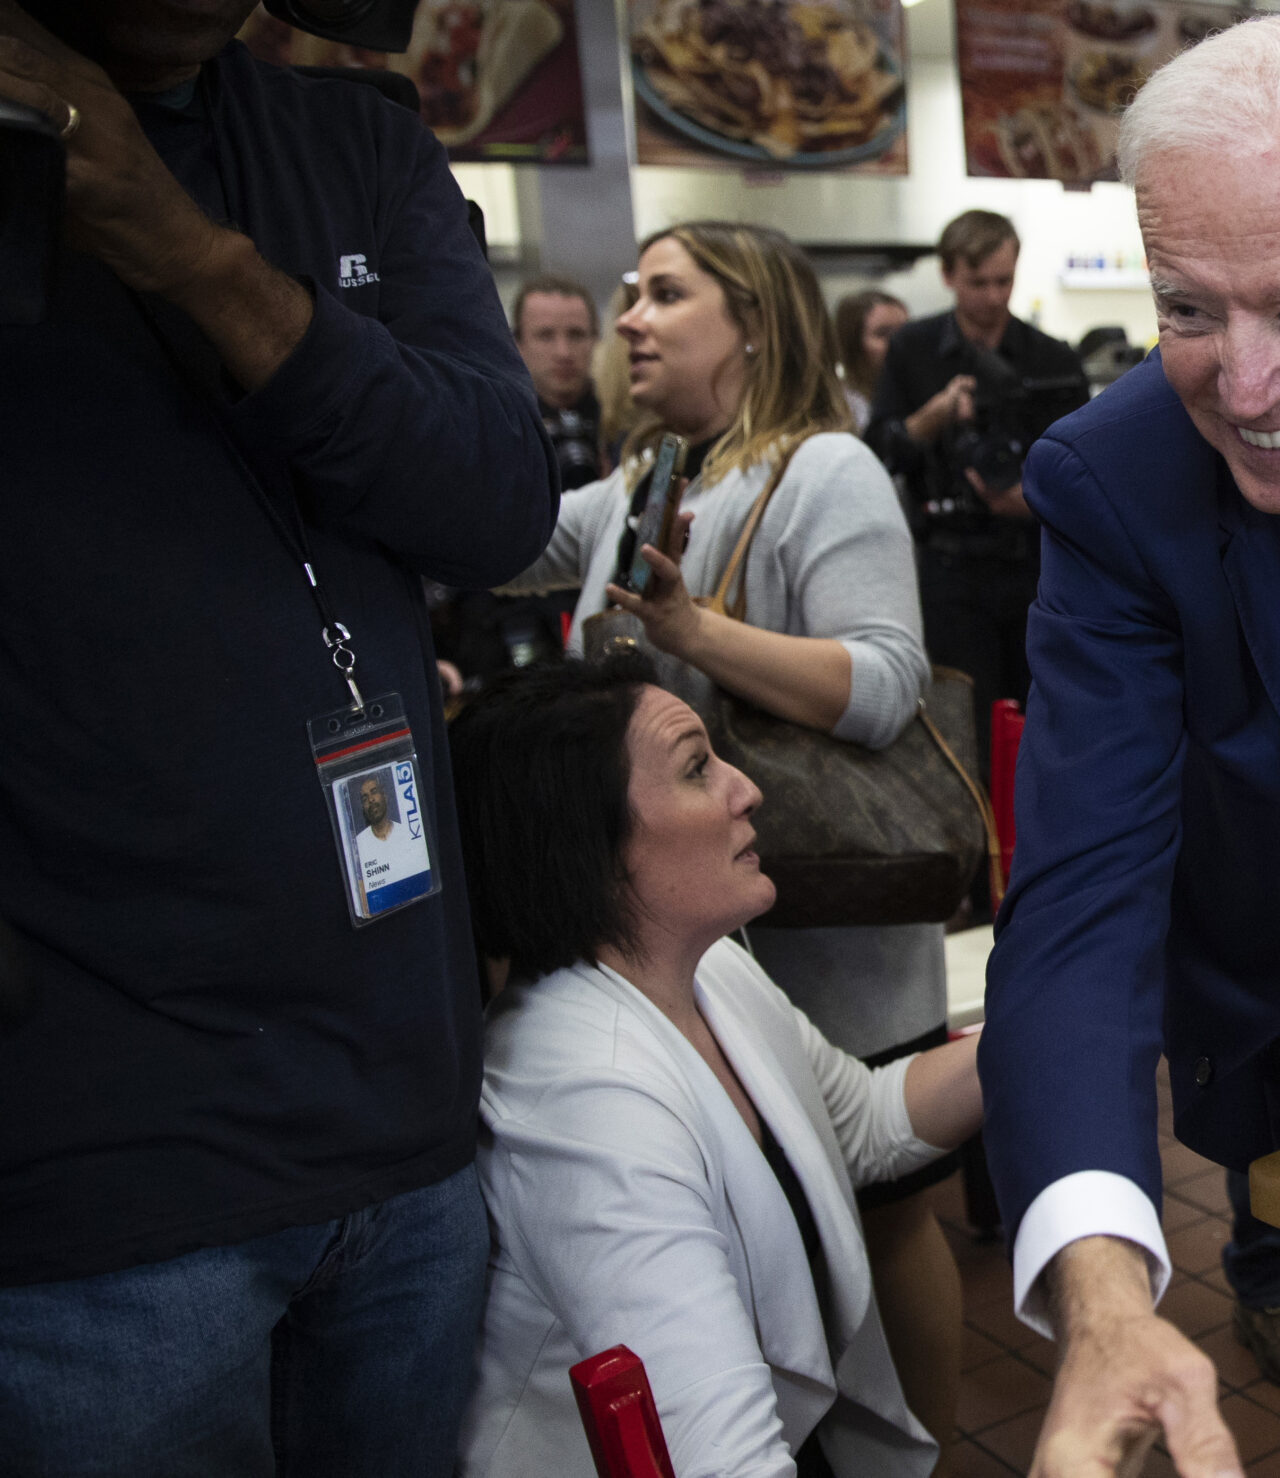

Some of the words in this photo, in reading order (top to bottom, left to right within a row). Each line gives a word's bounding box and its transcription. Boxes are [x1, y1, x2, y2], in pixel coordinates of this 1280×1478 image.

[364, 859, 378, 868] ERIC
[366, 863, 390, 878] SHINN
[368, 878, 386, 889] News
